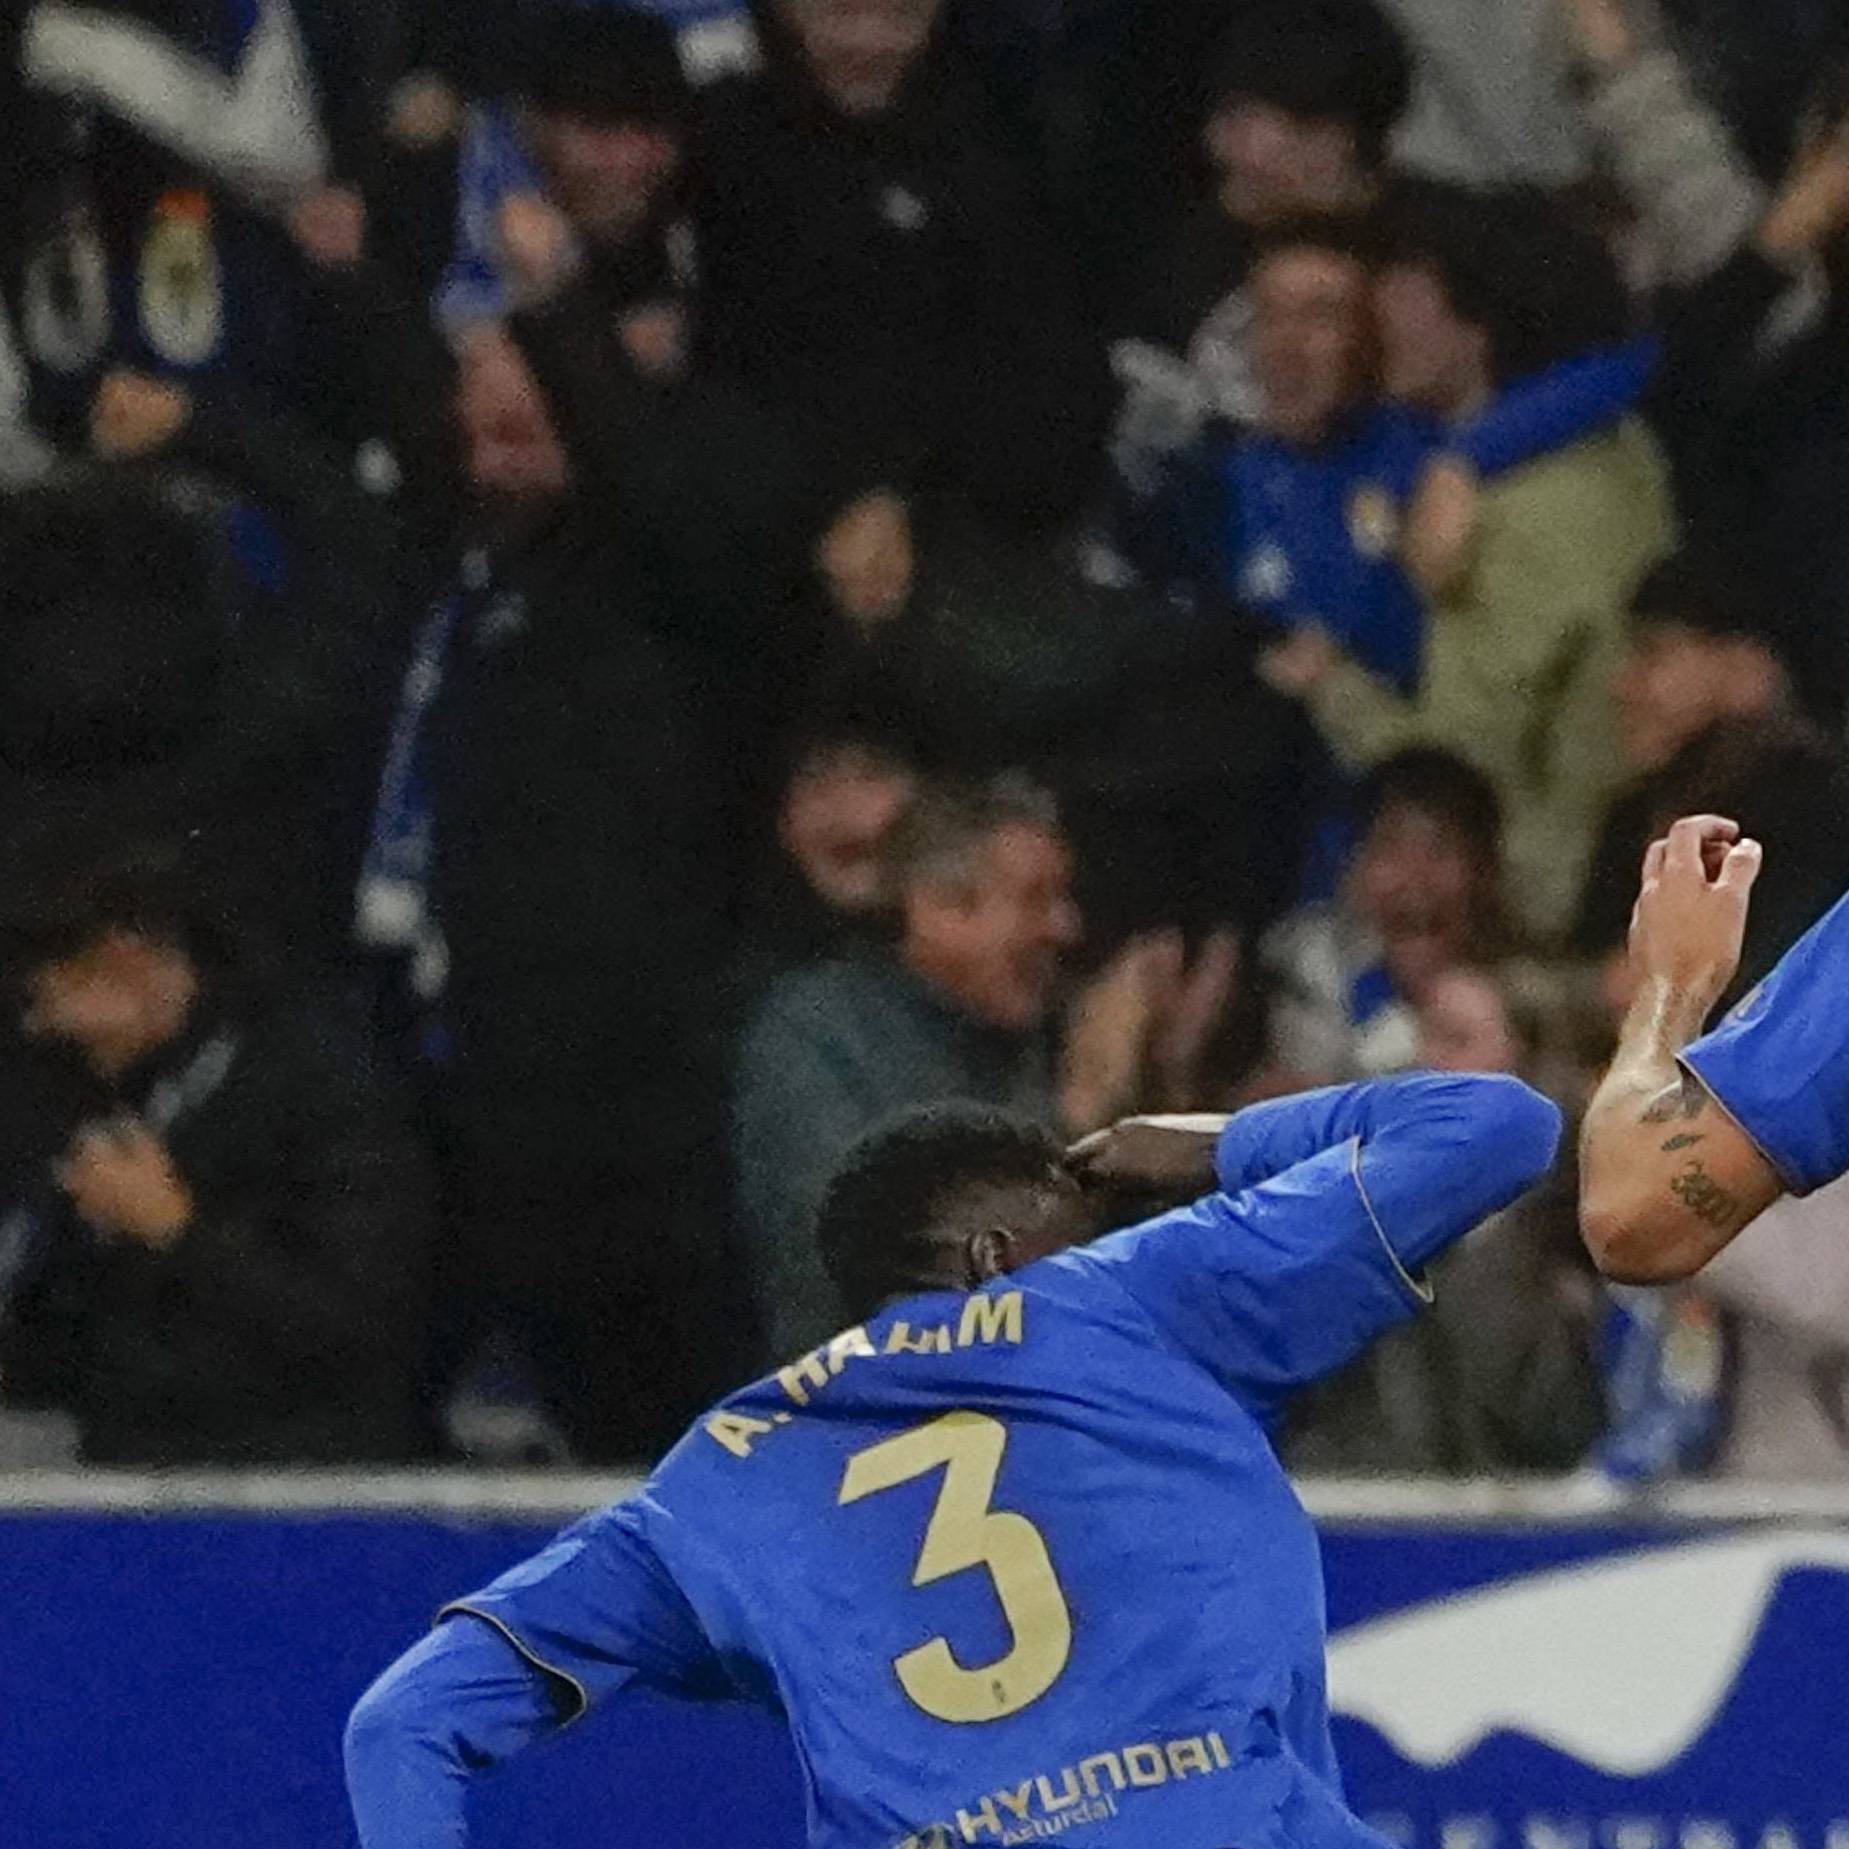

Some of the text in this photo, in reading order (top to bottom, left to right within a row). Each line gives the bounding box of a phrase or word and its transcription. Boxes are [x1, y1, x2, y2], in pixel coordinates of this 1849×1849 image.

[704, 1407, 793, 1459] A.
[838, 1410, 1072, 1723] 3
[955, 1731, 1231, 1845] HYUNDAI
